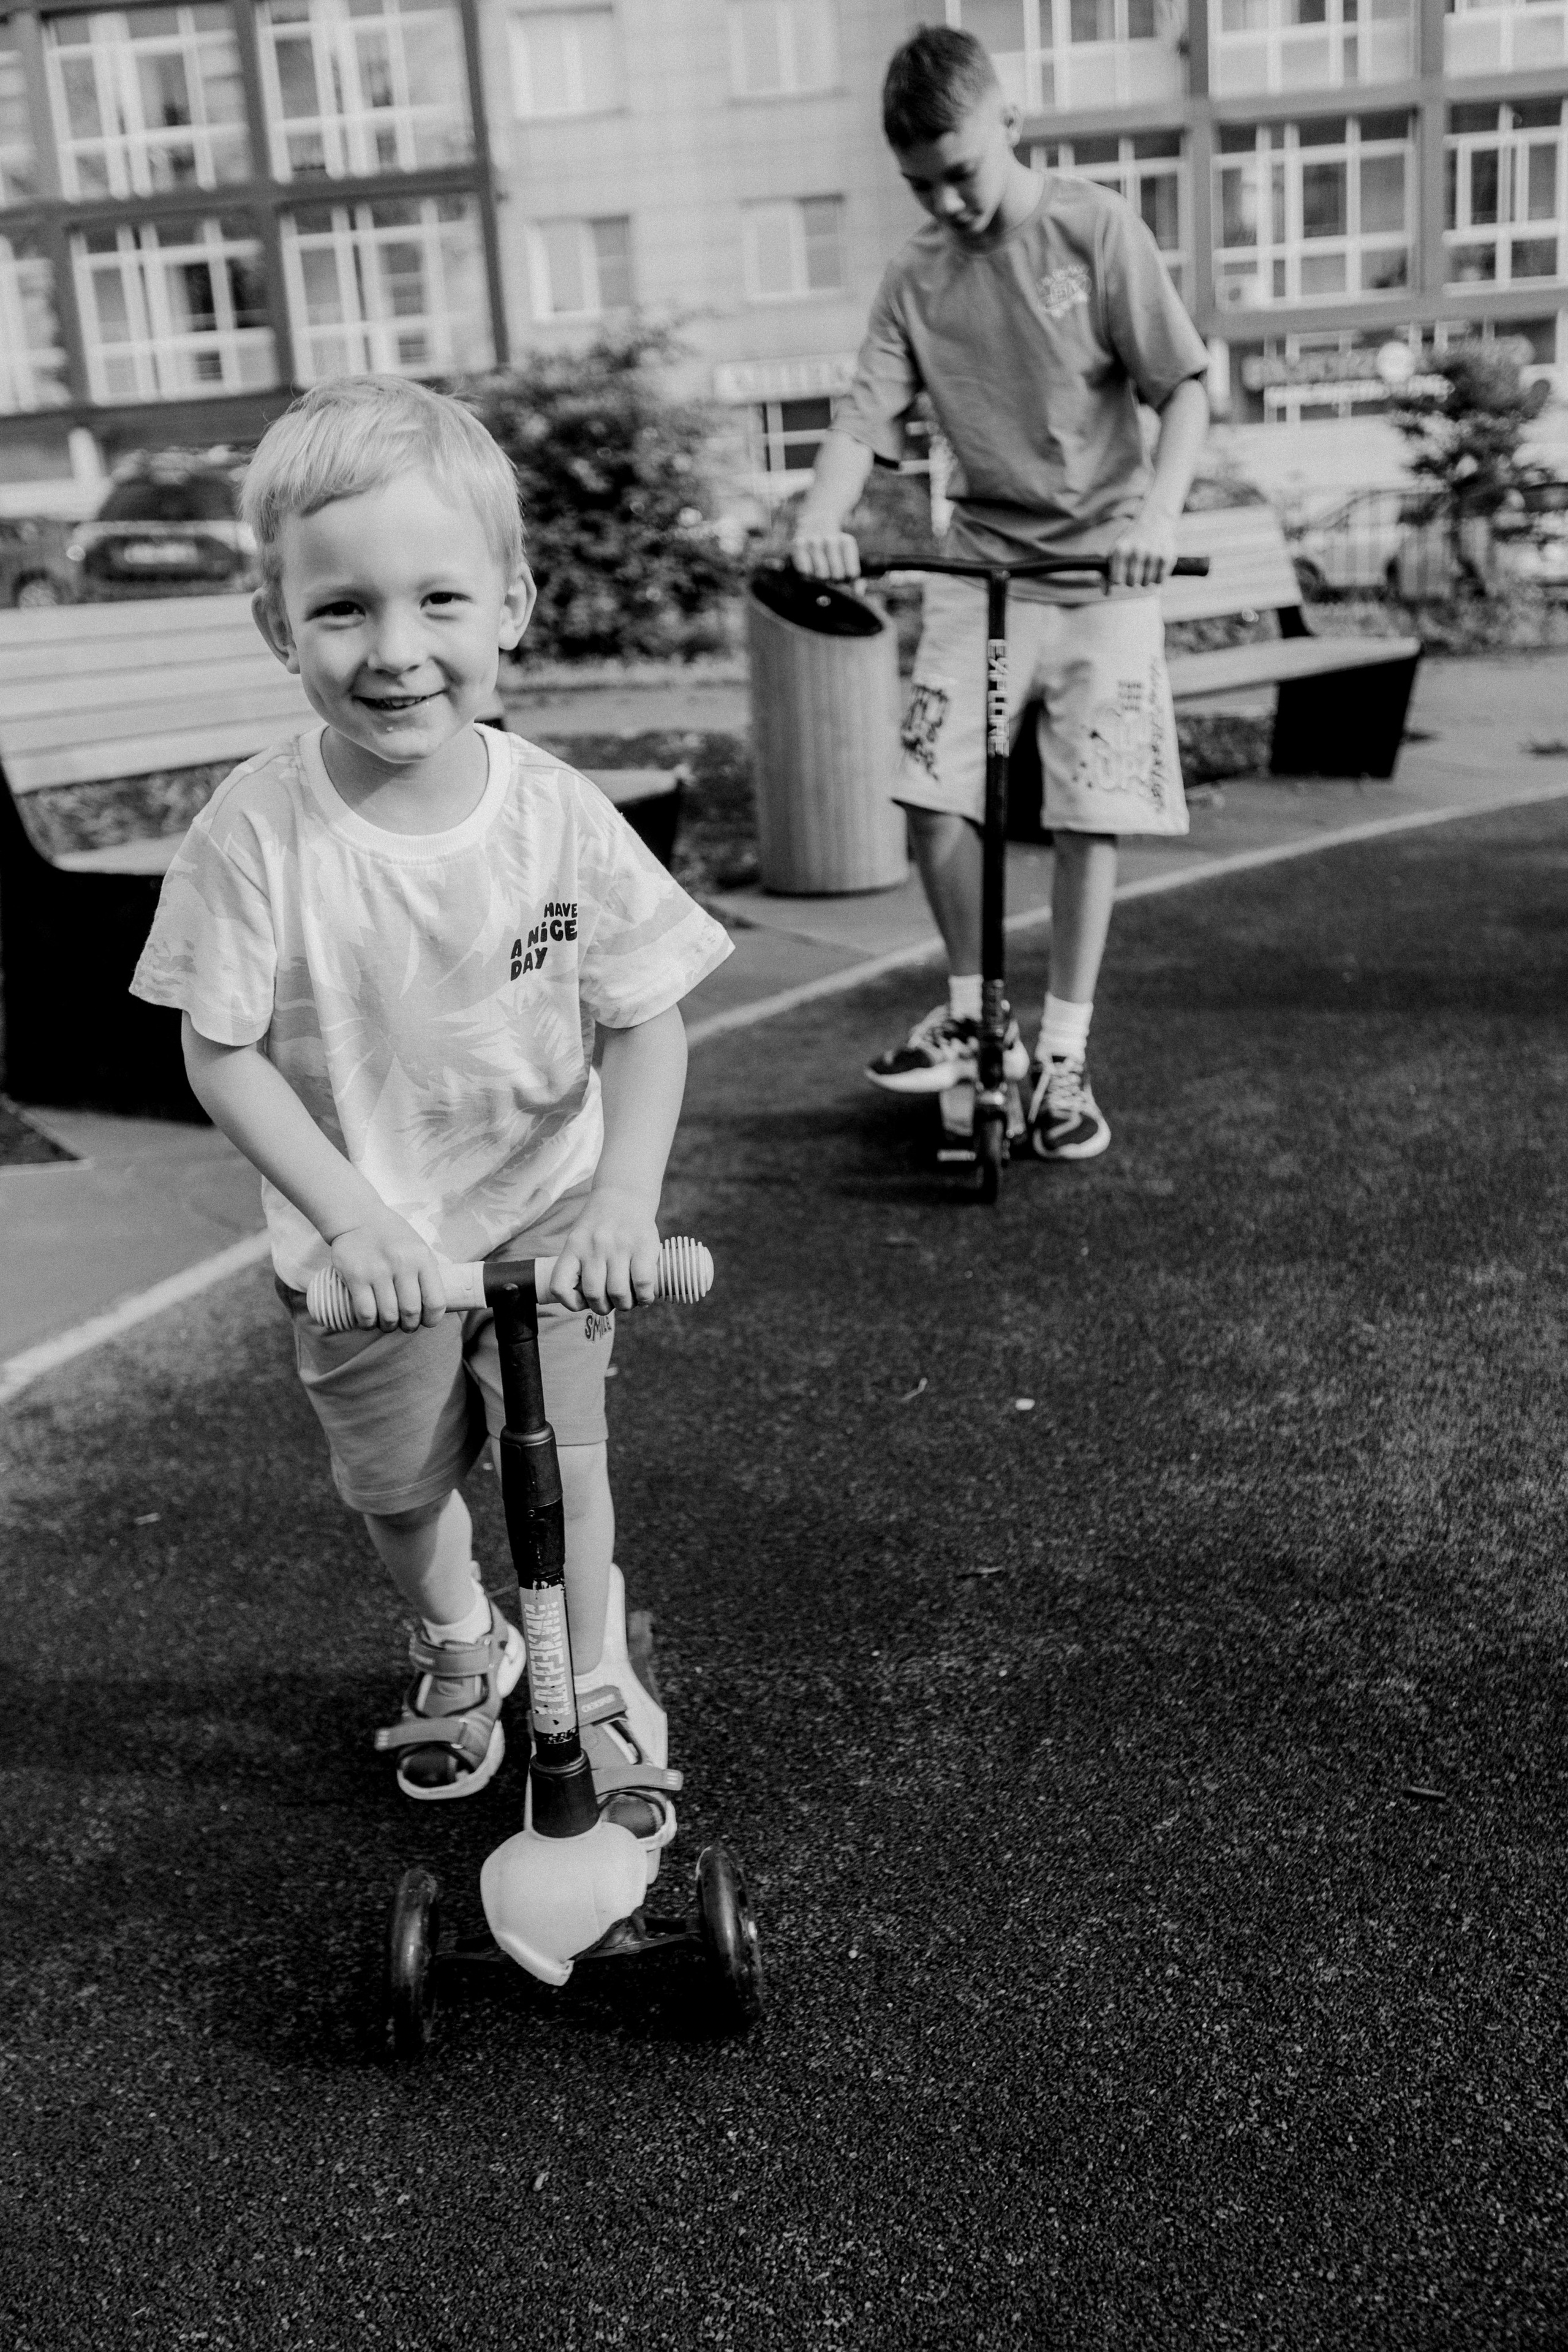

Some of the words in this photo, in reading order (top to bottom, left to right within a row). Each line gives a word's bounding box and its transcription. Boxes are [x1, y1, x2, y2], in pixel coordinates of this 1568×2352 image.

[987, 639, 1010, 758] EXPLORE
[544, 902, 578, 918] HAVE
[510, 938, 522, 960] A
[510, 947, 548, 981] DAY
[585, 1313, 612, 1342] SMILE
